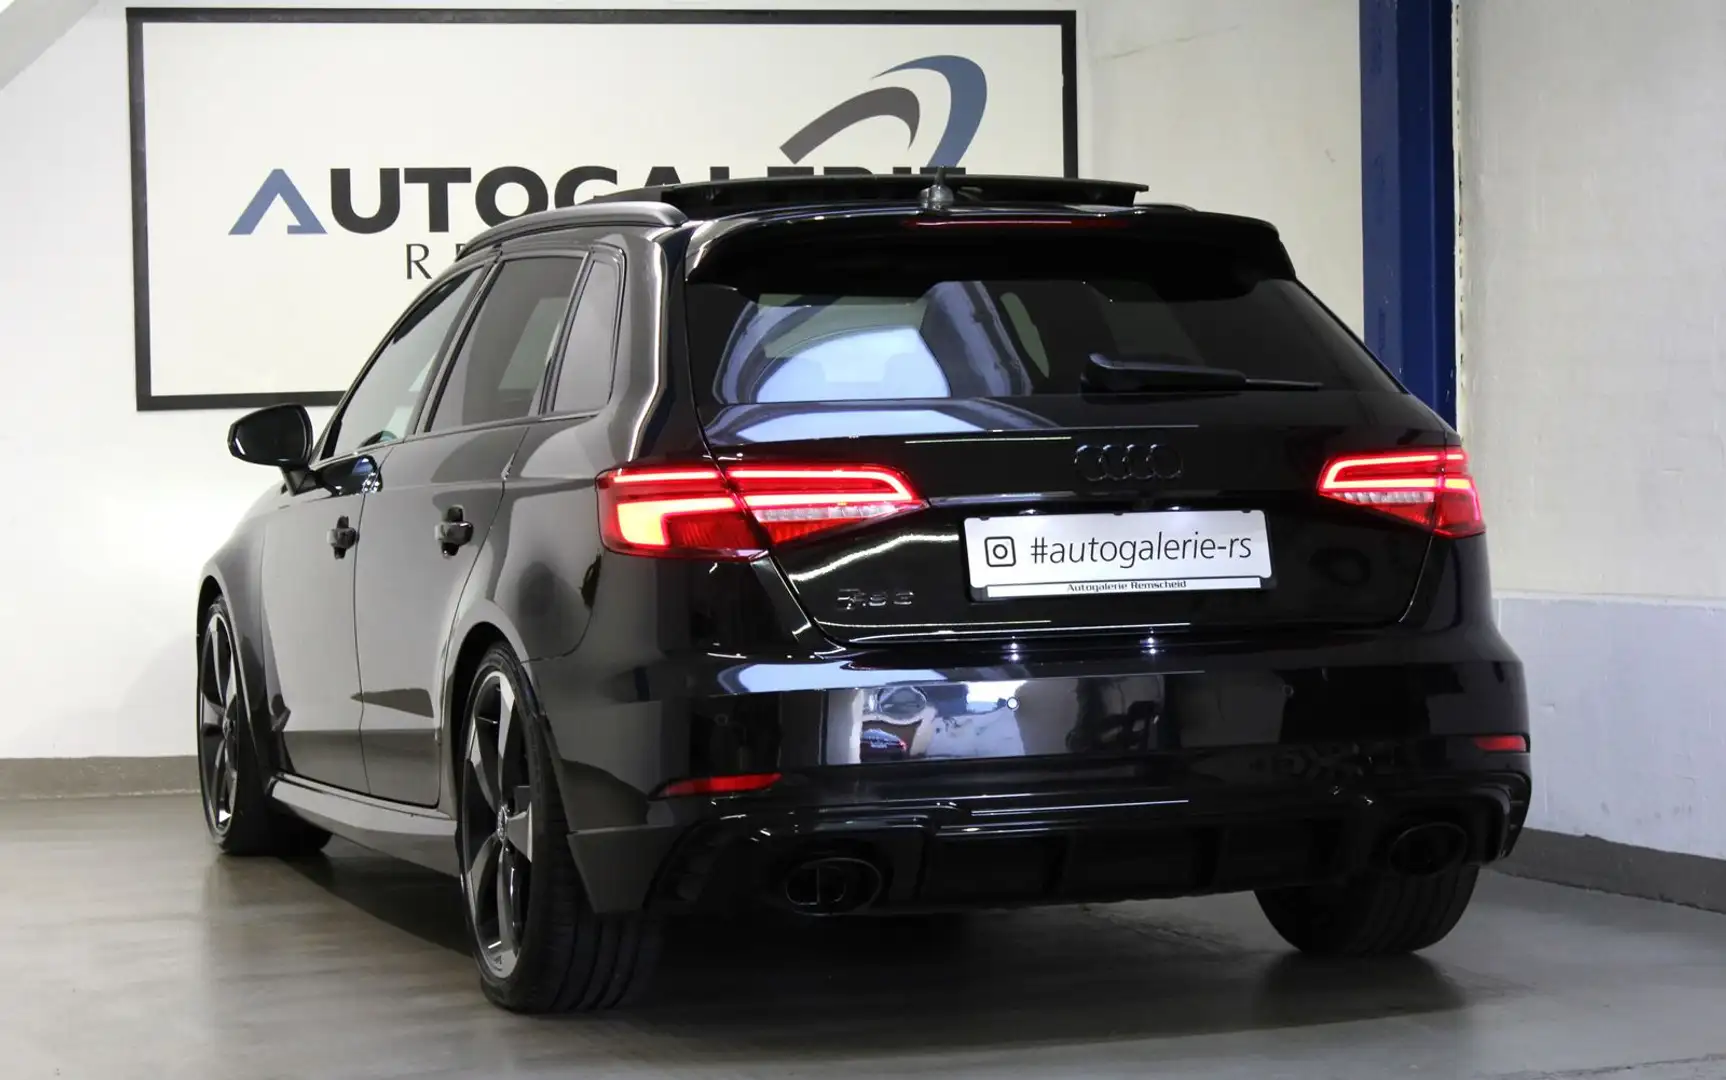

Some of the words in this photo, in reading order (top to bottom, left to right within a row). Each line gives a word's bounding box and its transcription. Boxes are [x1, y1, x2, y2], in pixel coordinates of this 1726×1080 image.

[1031, 531, 1252, 569] #autogalerie-rs
[1066, 583, 1128, 593] Autogalerie
[1130, 580, 1188, 590] Remscheid
